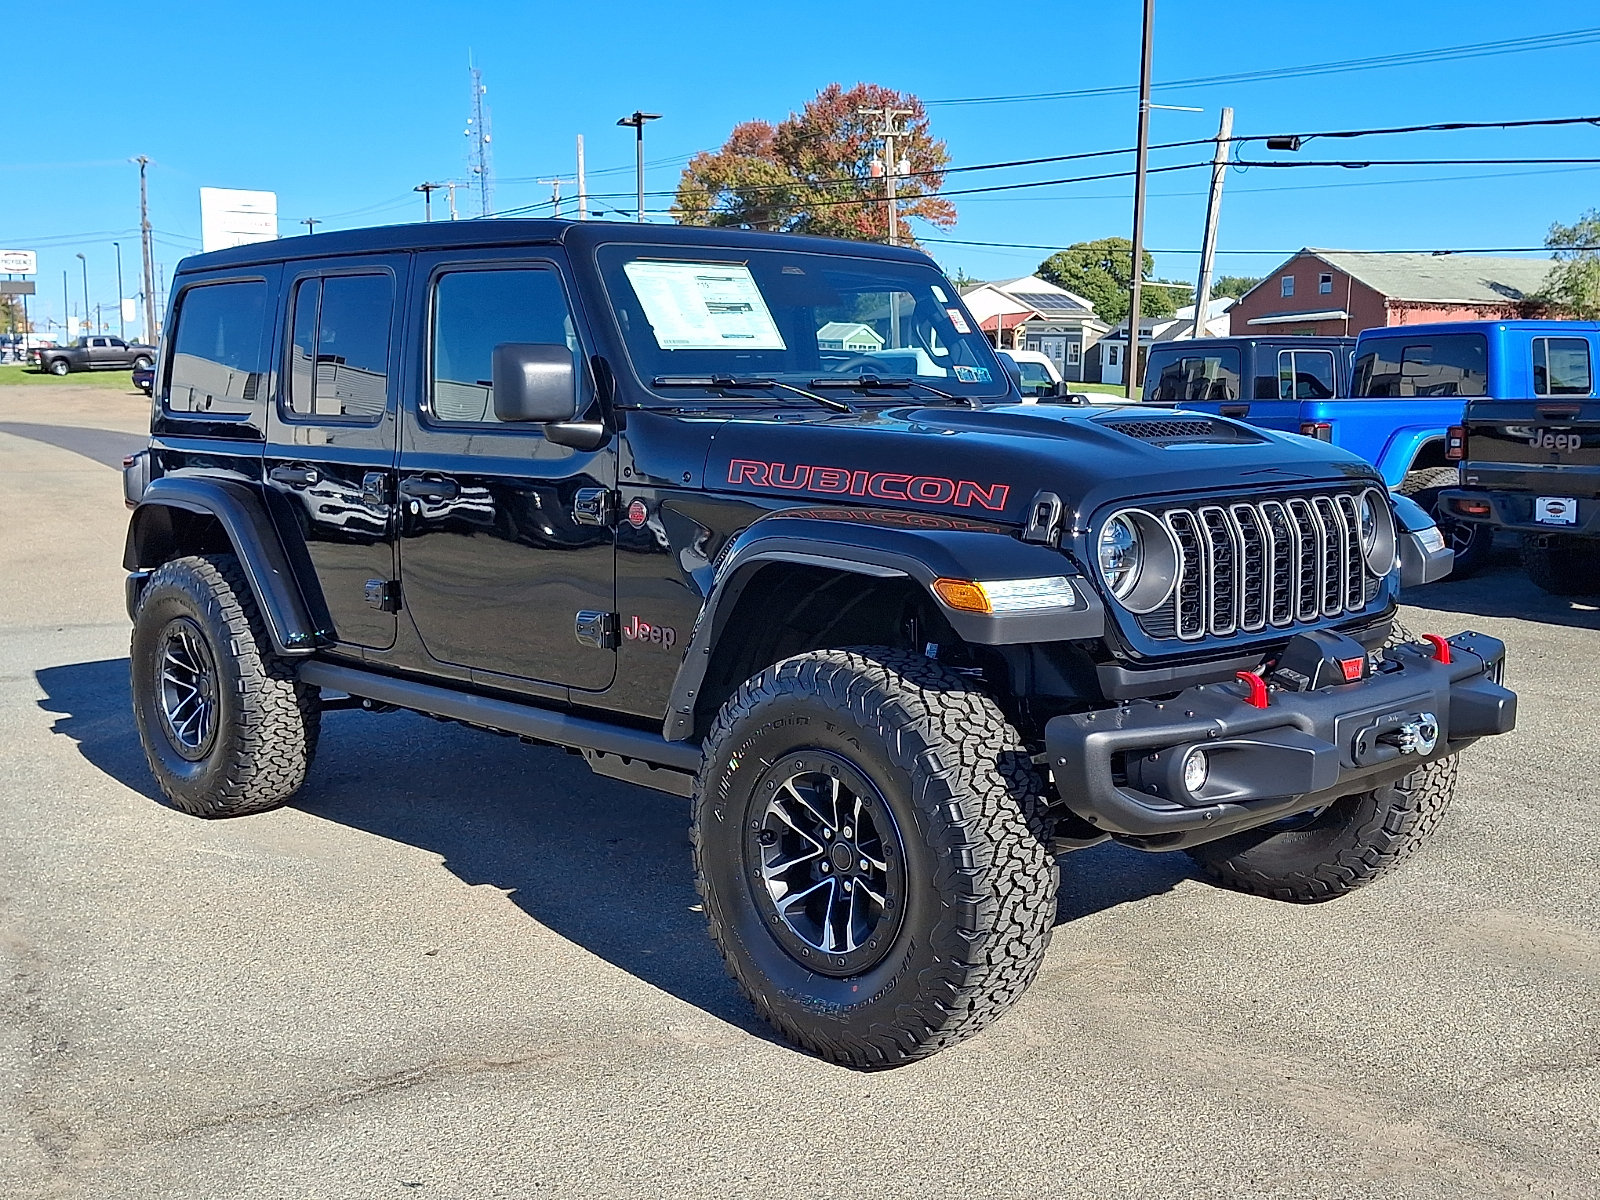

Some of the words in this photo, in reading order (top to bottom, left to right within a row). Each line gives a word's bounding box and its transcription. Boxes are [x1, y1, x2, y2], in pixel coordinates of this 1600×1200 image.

[1529, 428, 1581, 453] Jeep
[727, 459, 1009, 511] RUBICON
[623, 615, 676, 650] Jeep
